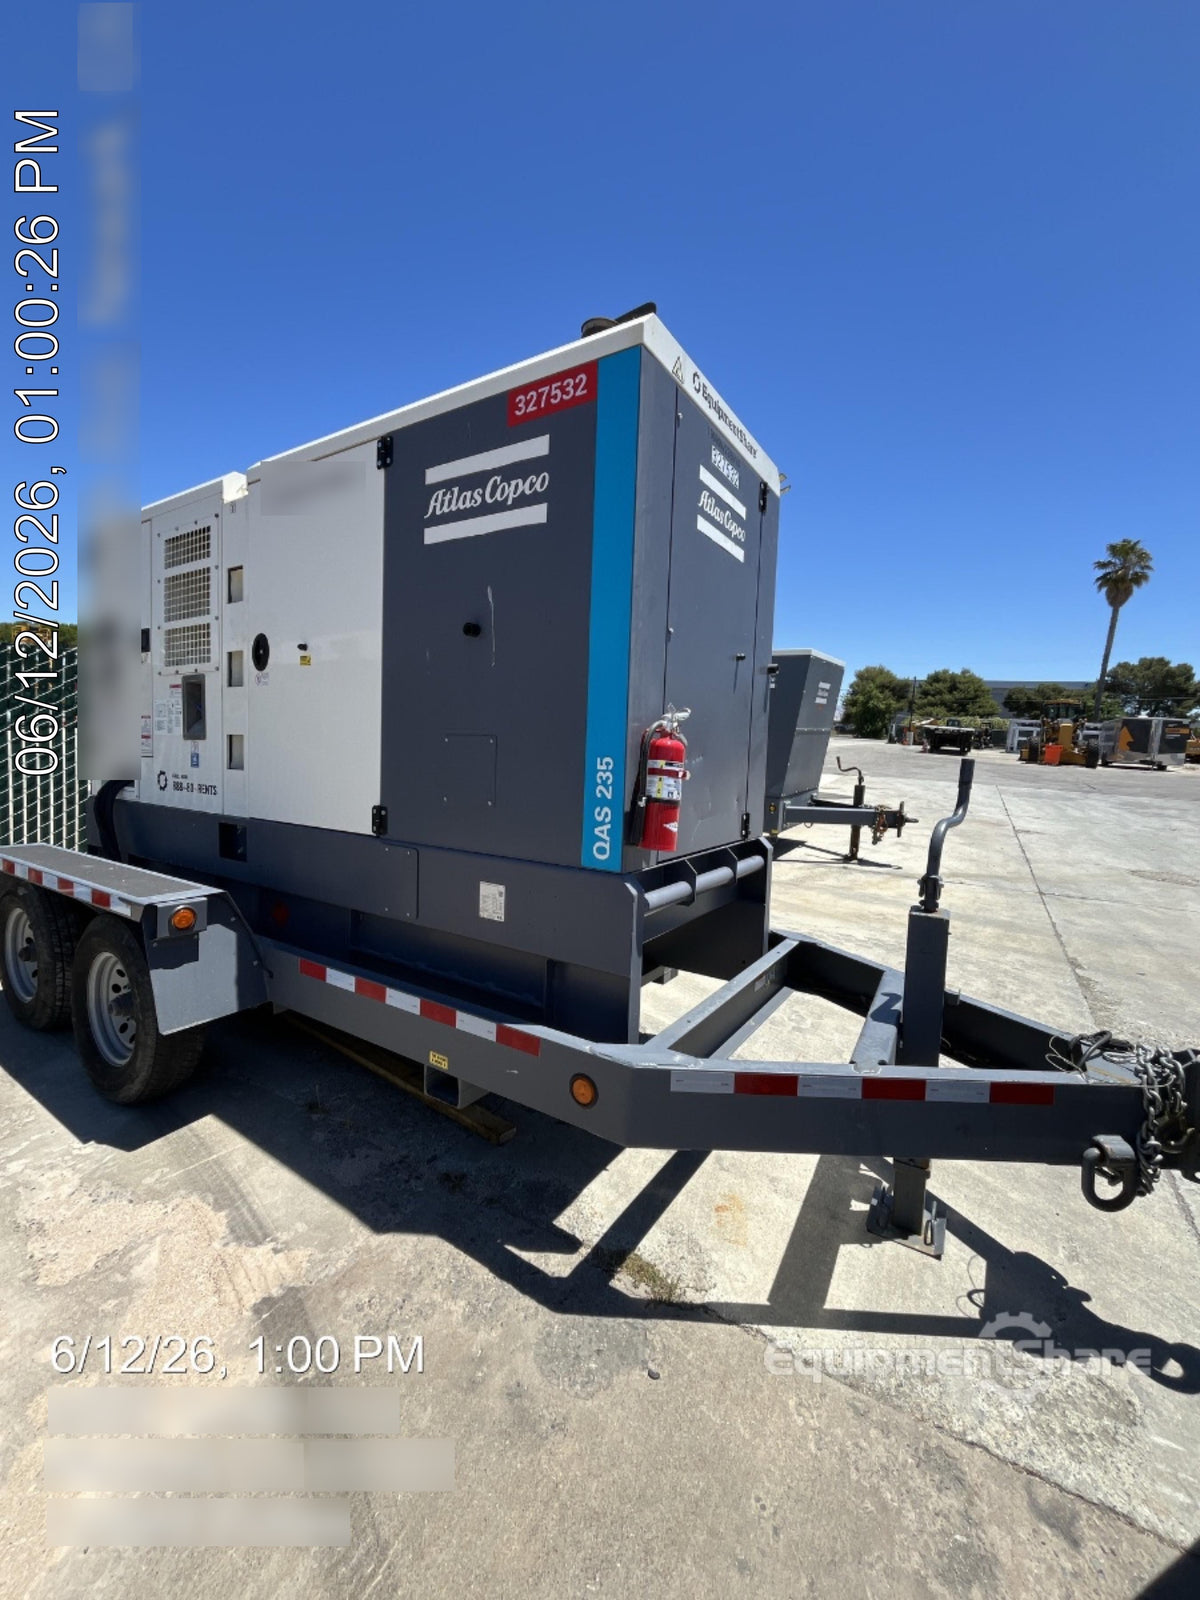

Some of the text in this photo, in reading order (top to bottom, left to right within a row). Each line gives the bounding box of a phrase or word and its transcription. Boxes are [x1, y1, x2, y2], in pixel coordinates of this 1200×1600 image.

[514, 373, 588, 416] 327532
[424, 472, 550, 519] Atlas Copco
[698, 490, 746, 543] Atlas Copco
[593, 757, 614, 860] QAS 235
